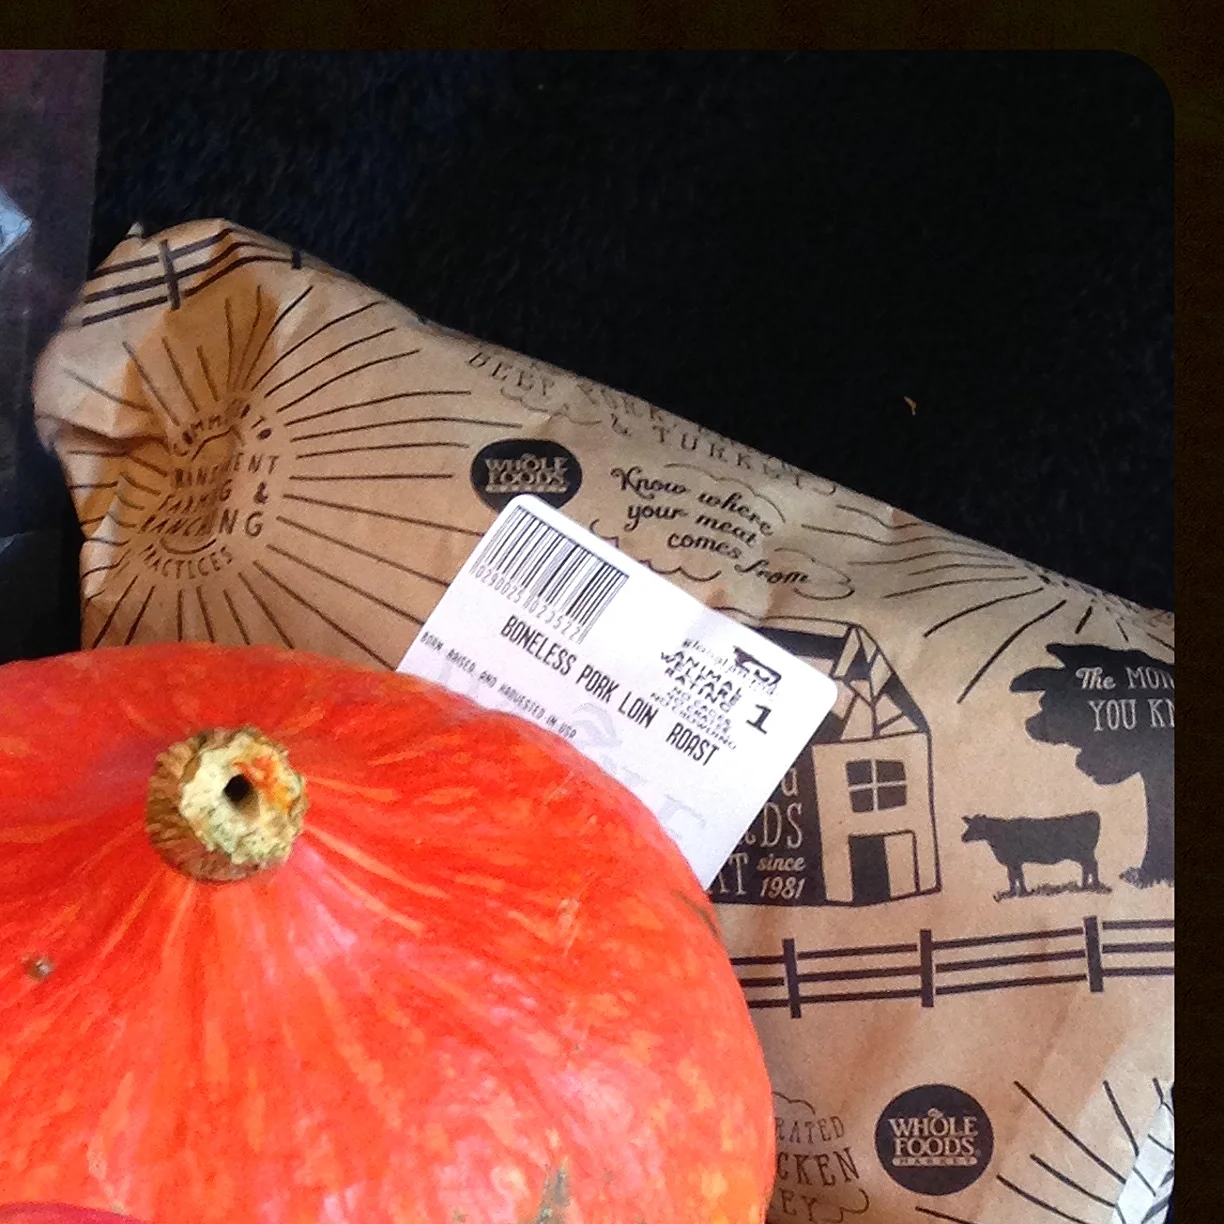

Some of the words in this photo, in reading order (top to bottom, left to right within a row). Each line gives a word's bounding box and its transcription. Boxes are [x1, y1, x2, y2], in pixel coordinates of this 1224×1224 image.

[484, 454, 569, 472] WHOLE
[487, 470, 565, 485] FOODS
[611, 466, 687, 499] Know
[697, 492, 775, 536] where
[624, 504, 688, 532] your
[694, 512, 759, 548] meat
[667, 531, 743, 560] comes
[734, 559, 808, 585] from
[498, 614, 578, 677] BONELESS
[574, 663, 620, 704] PORK
[617, 691, 659, 729] LOIN
[665, 722, 720, 767] ROAST
[660, 652, 741, 705] WELFARE
[663, 666, 732, 713] RATING
[672, 651, 742, 698] ANIMAL
[1075, 666, 1116, 690] The
[745, 703, 773, 735] 1
[1088, 698, 1136, 732] YOU
[756, 853, 806, 872] since
[759, 876, 806, 900] 1981
[888, 1110, 979, 1137] WHOLE
[893, 1136, 976, 1157] FOODS
